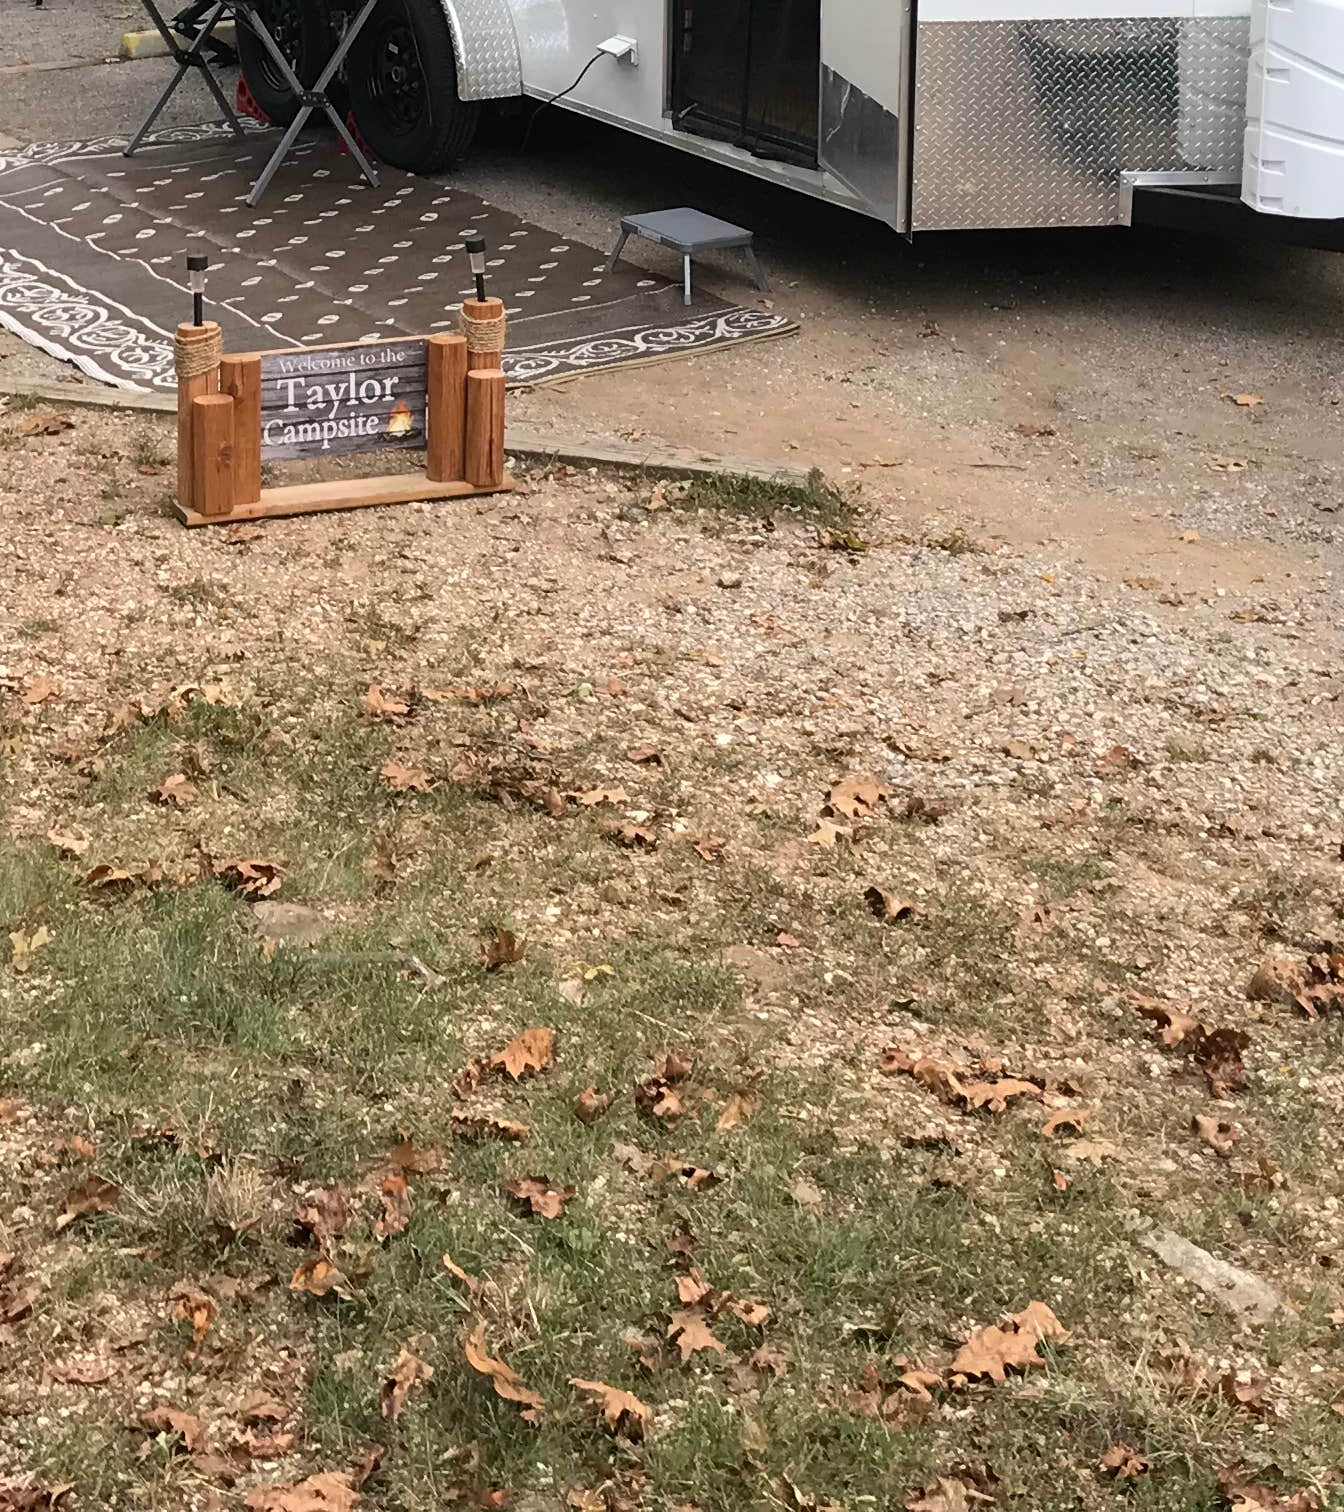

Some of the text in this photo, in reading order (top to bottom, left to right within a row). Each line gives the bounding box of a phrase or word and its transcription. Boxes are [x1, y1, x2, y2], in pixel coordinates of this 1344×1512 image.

[278, 348, 406, 374] Welcome to the
[276, 372, 400, 420] Taylor
[262, 411, 380, 449] Campsite
